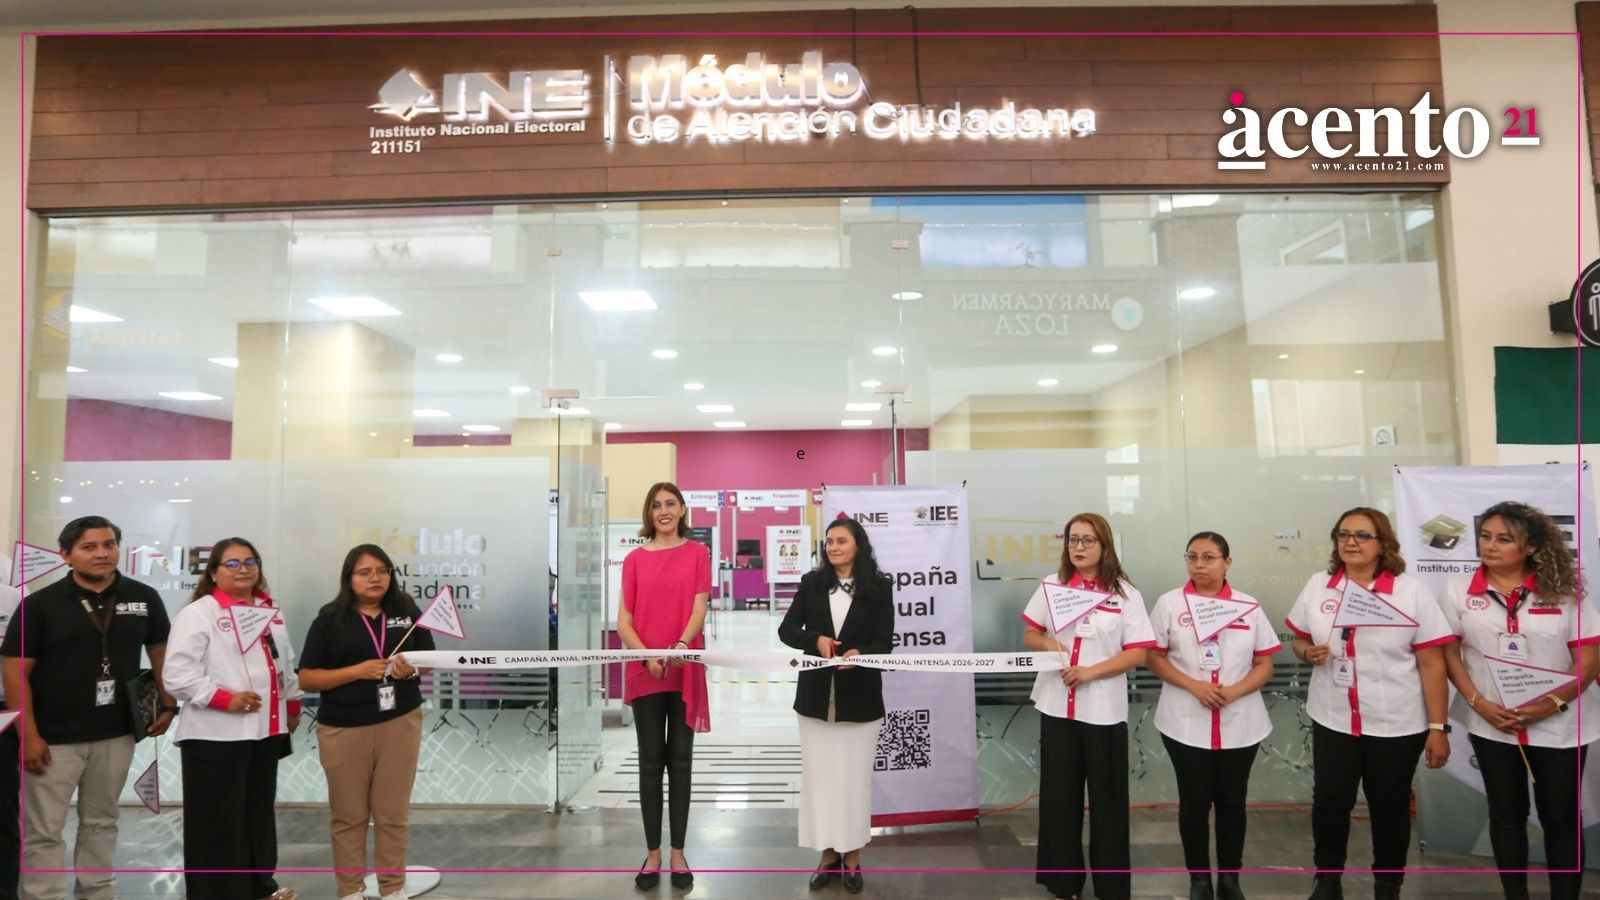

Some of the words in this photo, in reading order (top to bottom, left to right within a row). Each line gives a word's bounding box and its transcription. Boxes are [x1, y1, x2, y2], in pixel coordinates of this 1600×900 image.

[628, 52, 864, 106] Módulo
[443, 70, 588, 119] INE
[370, 126, 436, 138] Instituto
[440, 122, 509, 136] Nacional
[514, 119, 586, 134] Electoral
[628, 108, 681, 142] de
[863, 101, 1096, 140] Ciudadana
[371, 140, 421, 154] 211151
[853, 512, 888, 523] INE
[930, 506, 958, 521] IEE
[1417, 564, 1460, 574] Instituto
[882, 566, 958, 592] paña
[127, 602, 148, 612] IEE
[898, 597, 935, 617] ual
[892, 630, 946, 648] ensa
[470, 656, 497, 665] INE
[504, 655, 549, 664] CAMPAÑA
[913, 659, 949, 667] INTENSA
[952, 659, 995, 667] 2026-2027
[1015, 657, 1033, 667] IEE
